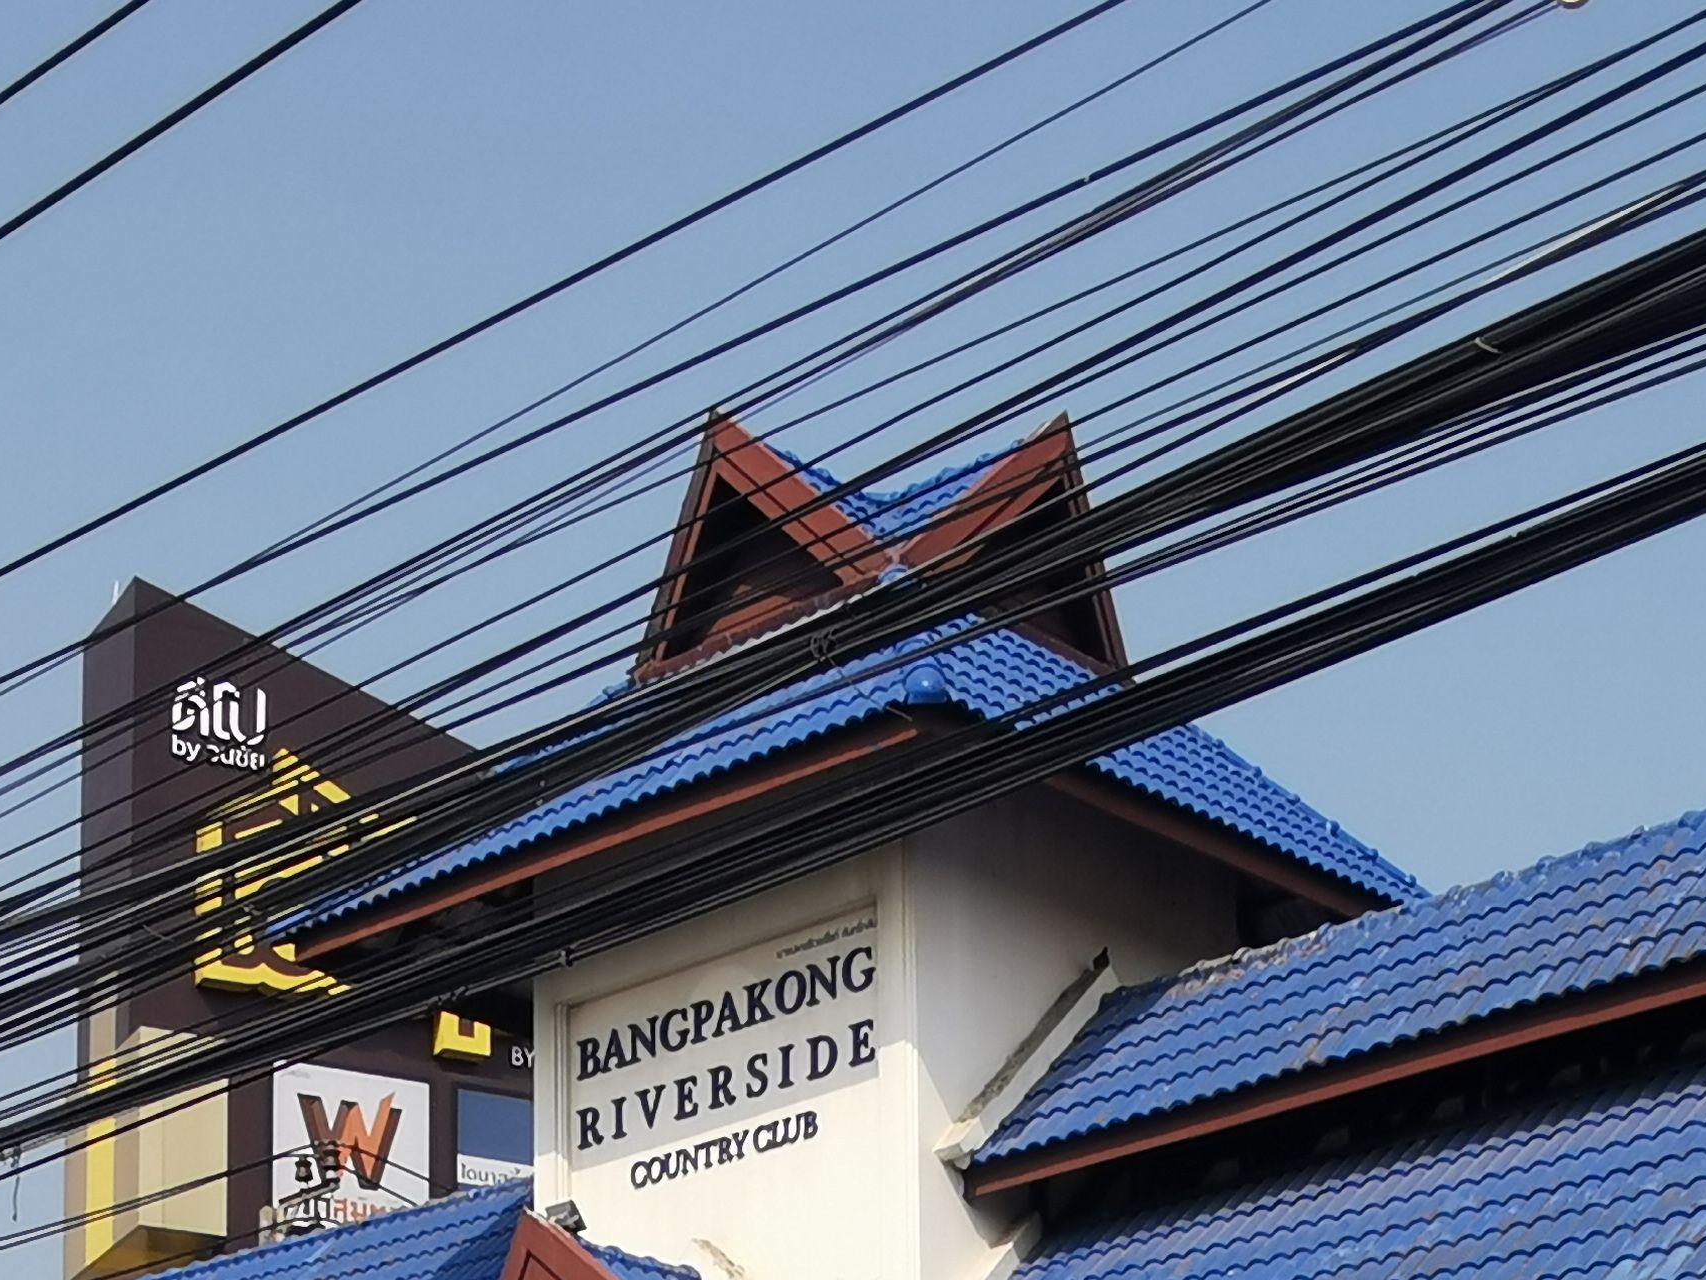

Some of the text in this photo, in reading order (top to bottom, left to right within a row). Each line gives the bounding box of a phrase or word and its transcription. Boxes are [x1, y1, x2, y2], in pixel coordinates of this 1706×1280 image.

[172, 734, 201, 762] by
[576, 947, 876, 1081] BANGPAKONG
[576, 1019, 876, 1150] RIVERSIDE
[631, 1111, 819, 1189] COUNTRY CLUB
